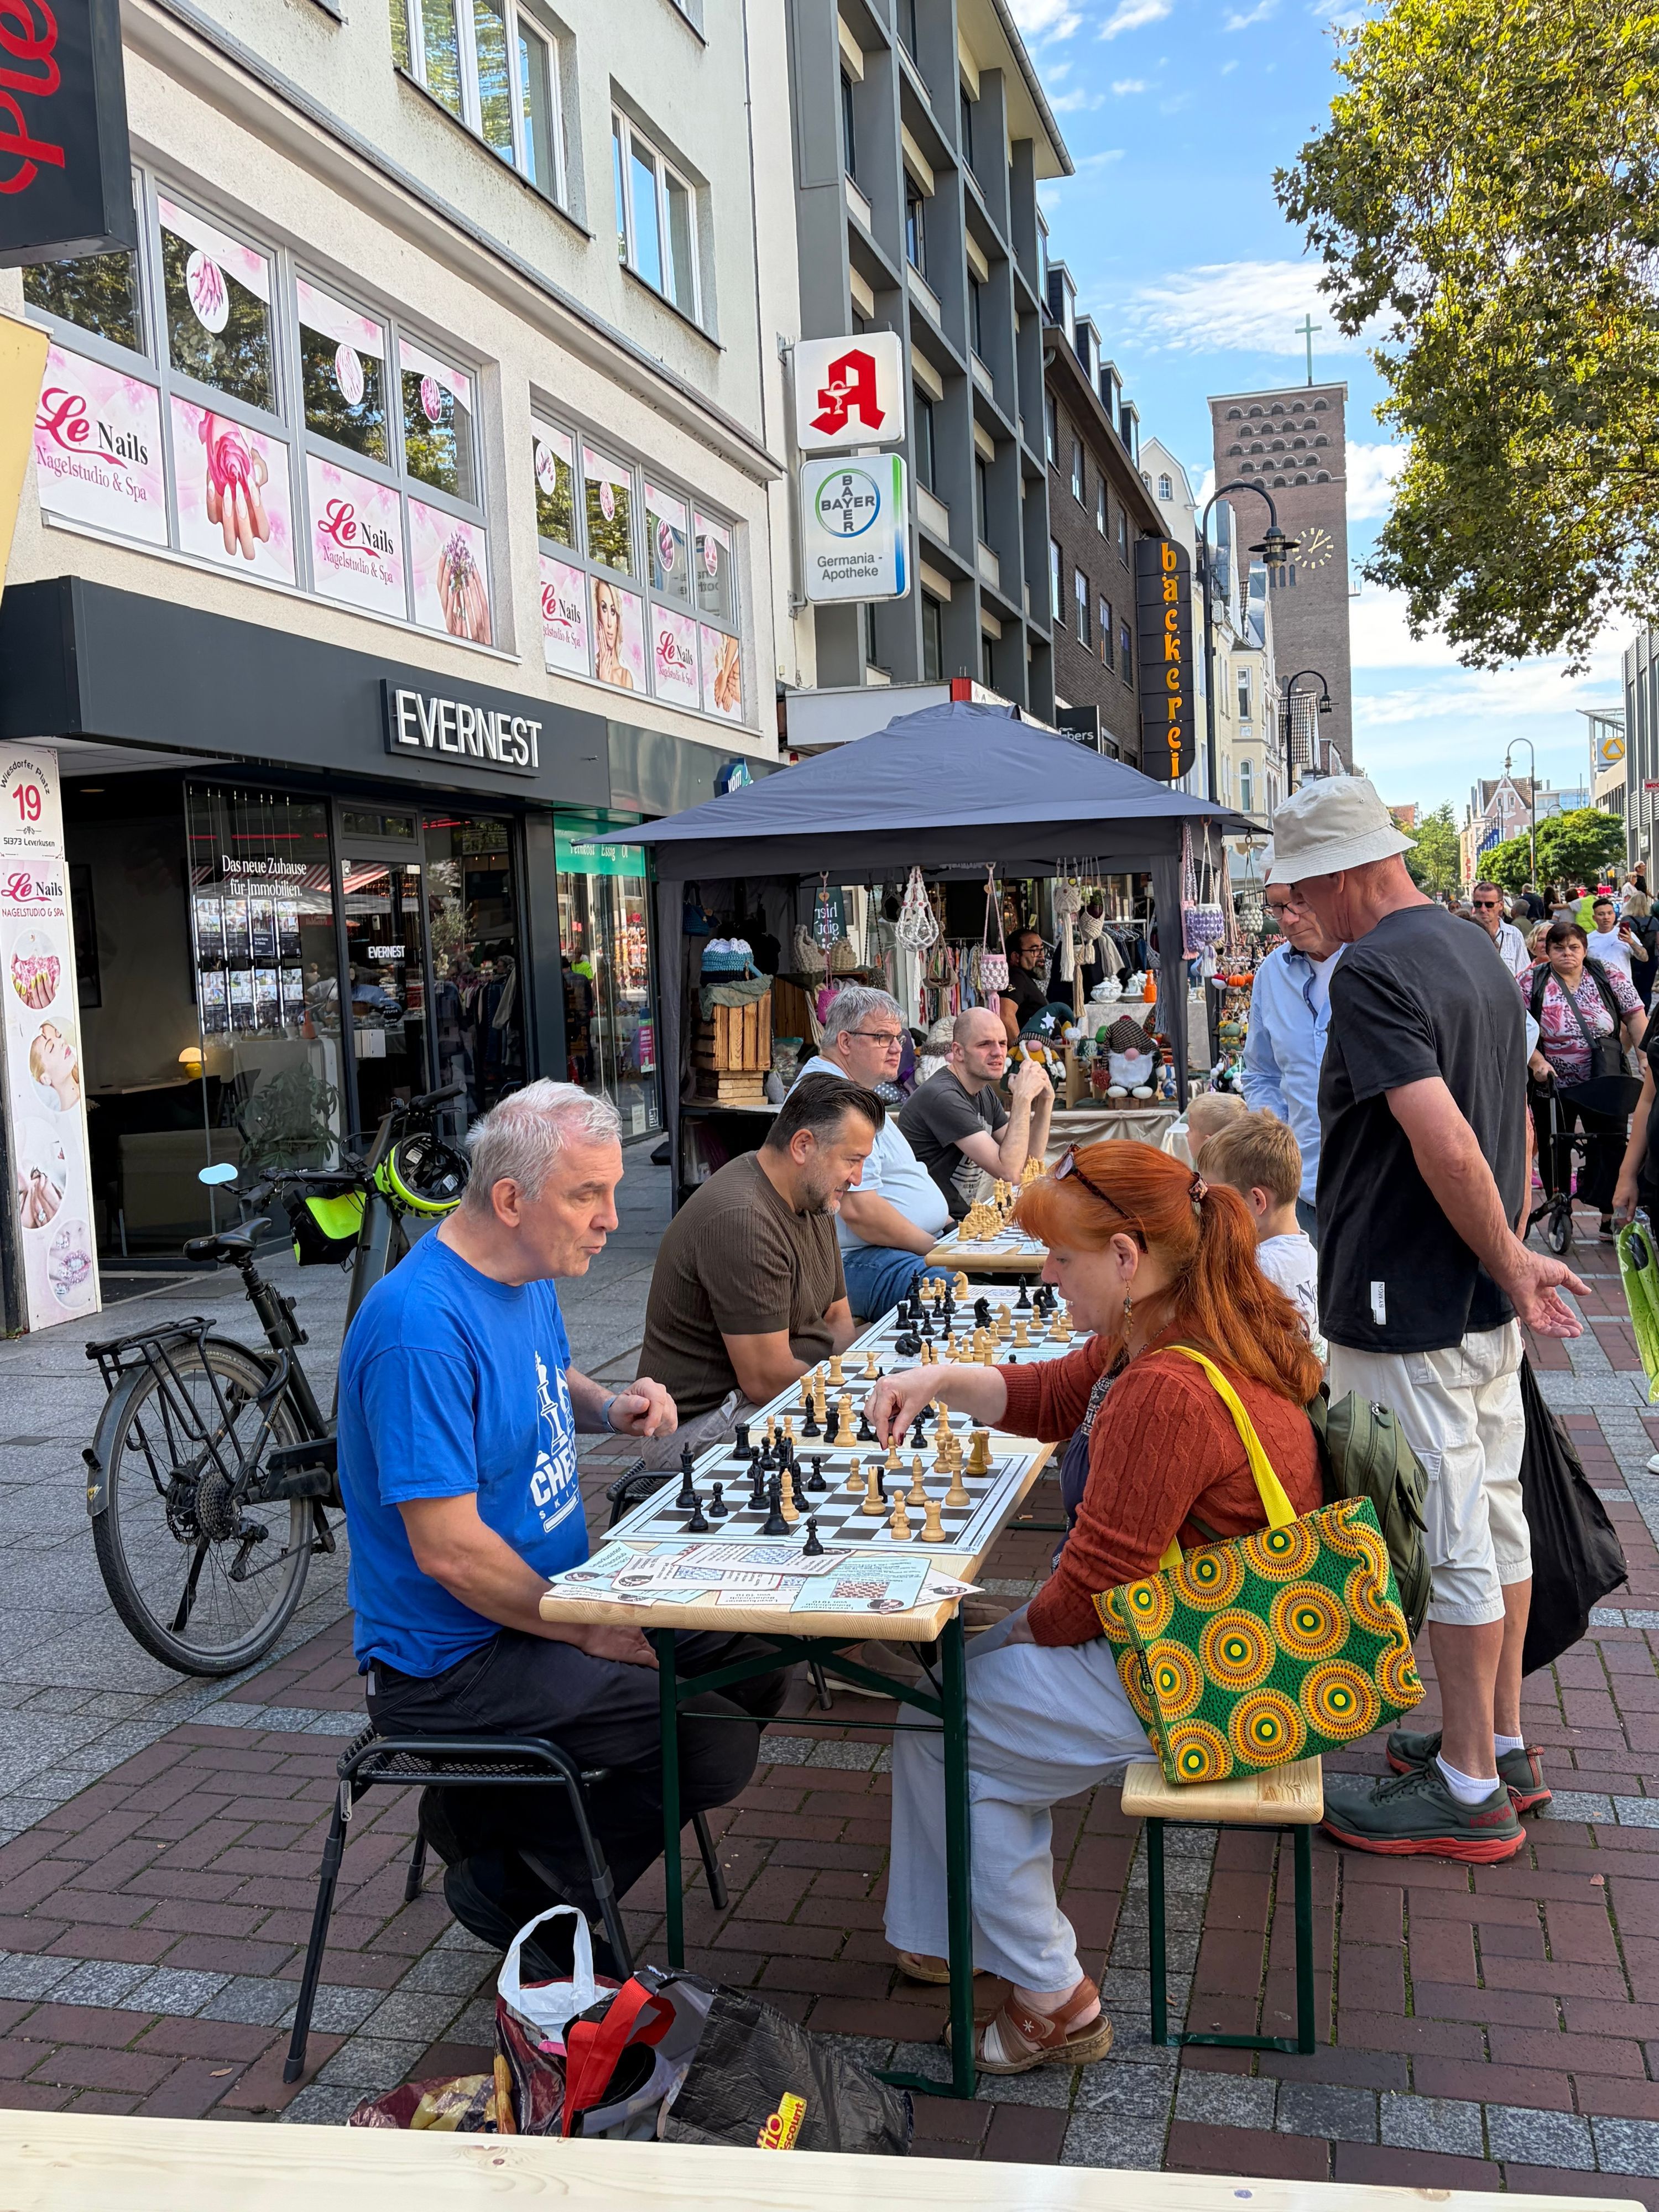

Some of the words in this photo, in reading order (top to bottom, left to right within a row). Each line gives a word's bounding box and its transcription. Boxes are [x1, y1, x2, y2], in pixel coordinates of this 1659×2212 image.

[35, 388, 97, 455] Le
[97, 420, 148, 465] Nails
[35, 445, 109, 488] Nagelstudio
[113, 472, 123, 492] &
[126, 477, 147, 503] Spa
[821, 495, 875, 510] BAYER
[842, 475, 854, 532] BAYER
[318, 499, 359, 547] Le
[361, 521, 394, 555] Nails
[323, 545, 369, 575] Nagelstudio
[371, 562, 378, 578] &
[379, 565, 393, 585] Spa
[817, 552, 874, 567] Germania
[822, 567, 879, 582] Apotheke
[559, 598, 581, 623] Nails
[571, 632, 581, 649] Spa
[656, 630, 675, 664] Le
[676, 645, 693, 665] Nails
[395, 689, 542, 768] EVERNEST
[1, 759, 34, 789] Wiesdorfer
[35, 767, 50, 795] Platz
[12, 784, 41, 821] 19
[3, 837, 22, 846] 51373
[24, 838, 55, 847] Leverkusen
[222, 855, 241, 872] Das
[243, 860, 266, 873] neue
[267, 858, 307, 875] Zuhause
[1, 873, 34, 900] Le
[35, 881, 63, 896] Nails
[230, 878, 246, 895] für
[247, 879, 302, 896] Immobilien.
[2, 908, 46, 917] NAGELSTUDIO
[54, 908, 64, 917] SPA
[368, 945, 405, 959] EVERNEST
